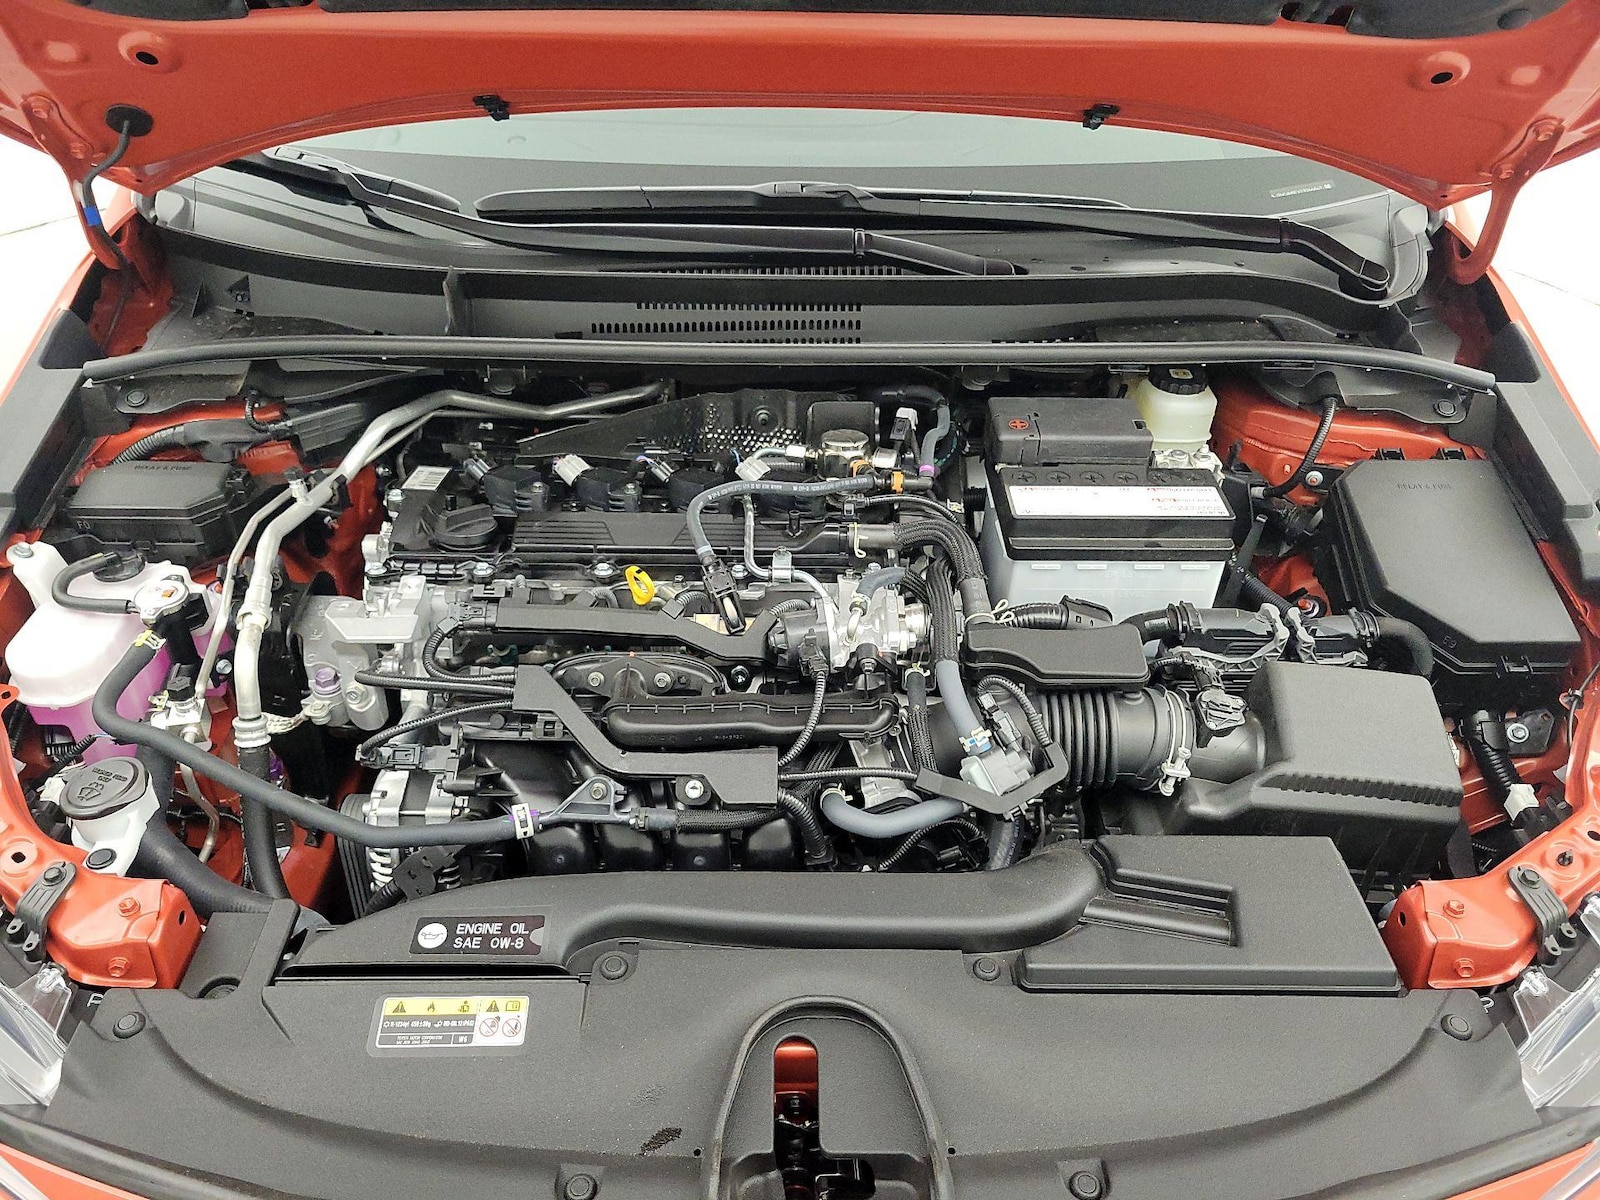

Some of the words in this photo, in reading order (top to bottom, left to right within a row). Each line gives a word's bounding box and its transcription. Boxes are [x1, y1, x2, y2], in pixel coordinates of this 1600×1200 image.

[456, 923, 503, 935] ENGINE
[509, 922, 530, 935] OIL
[453, 936, 482, 949] SAE
